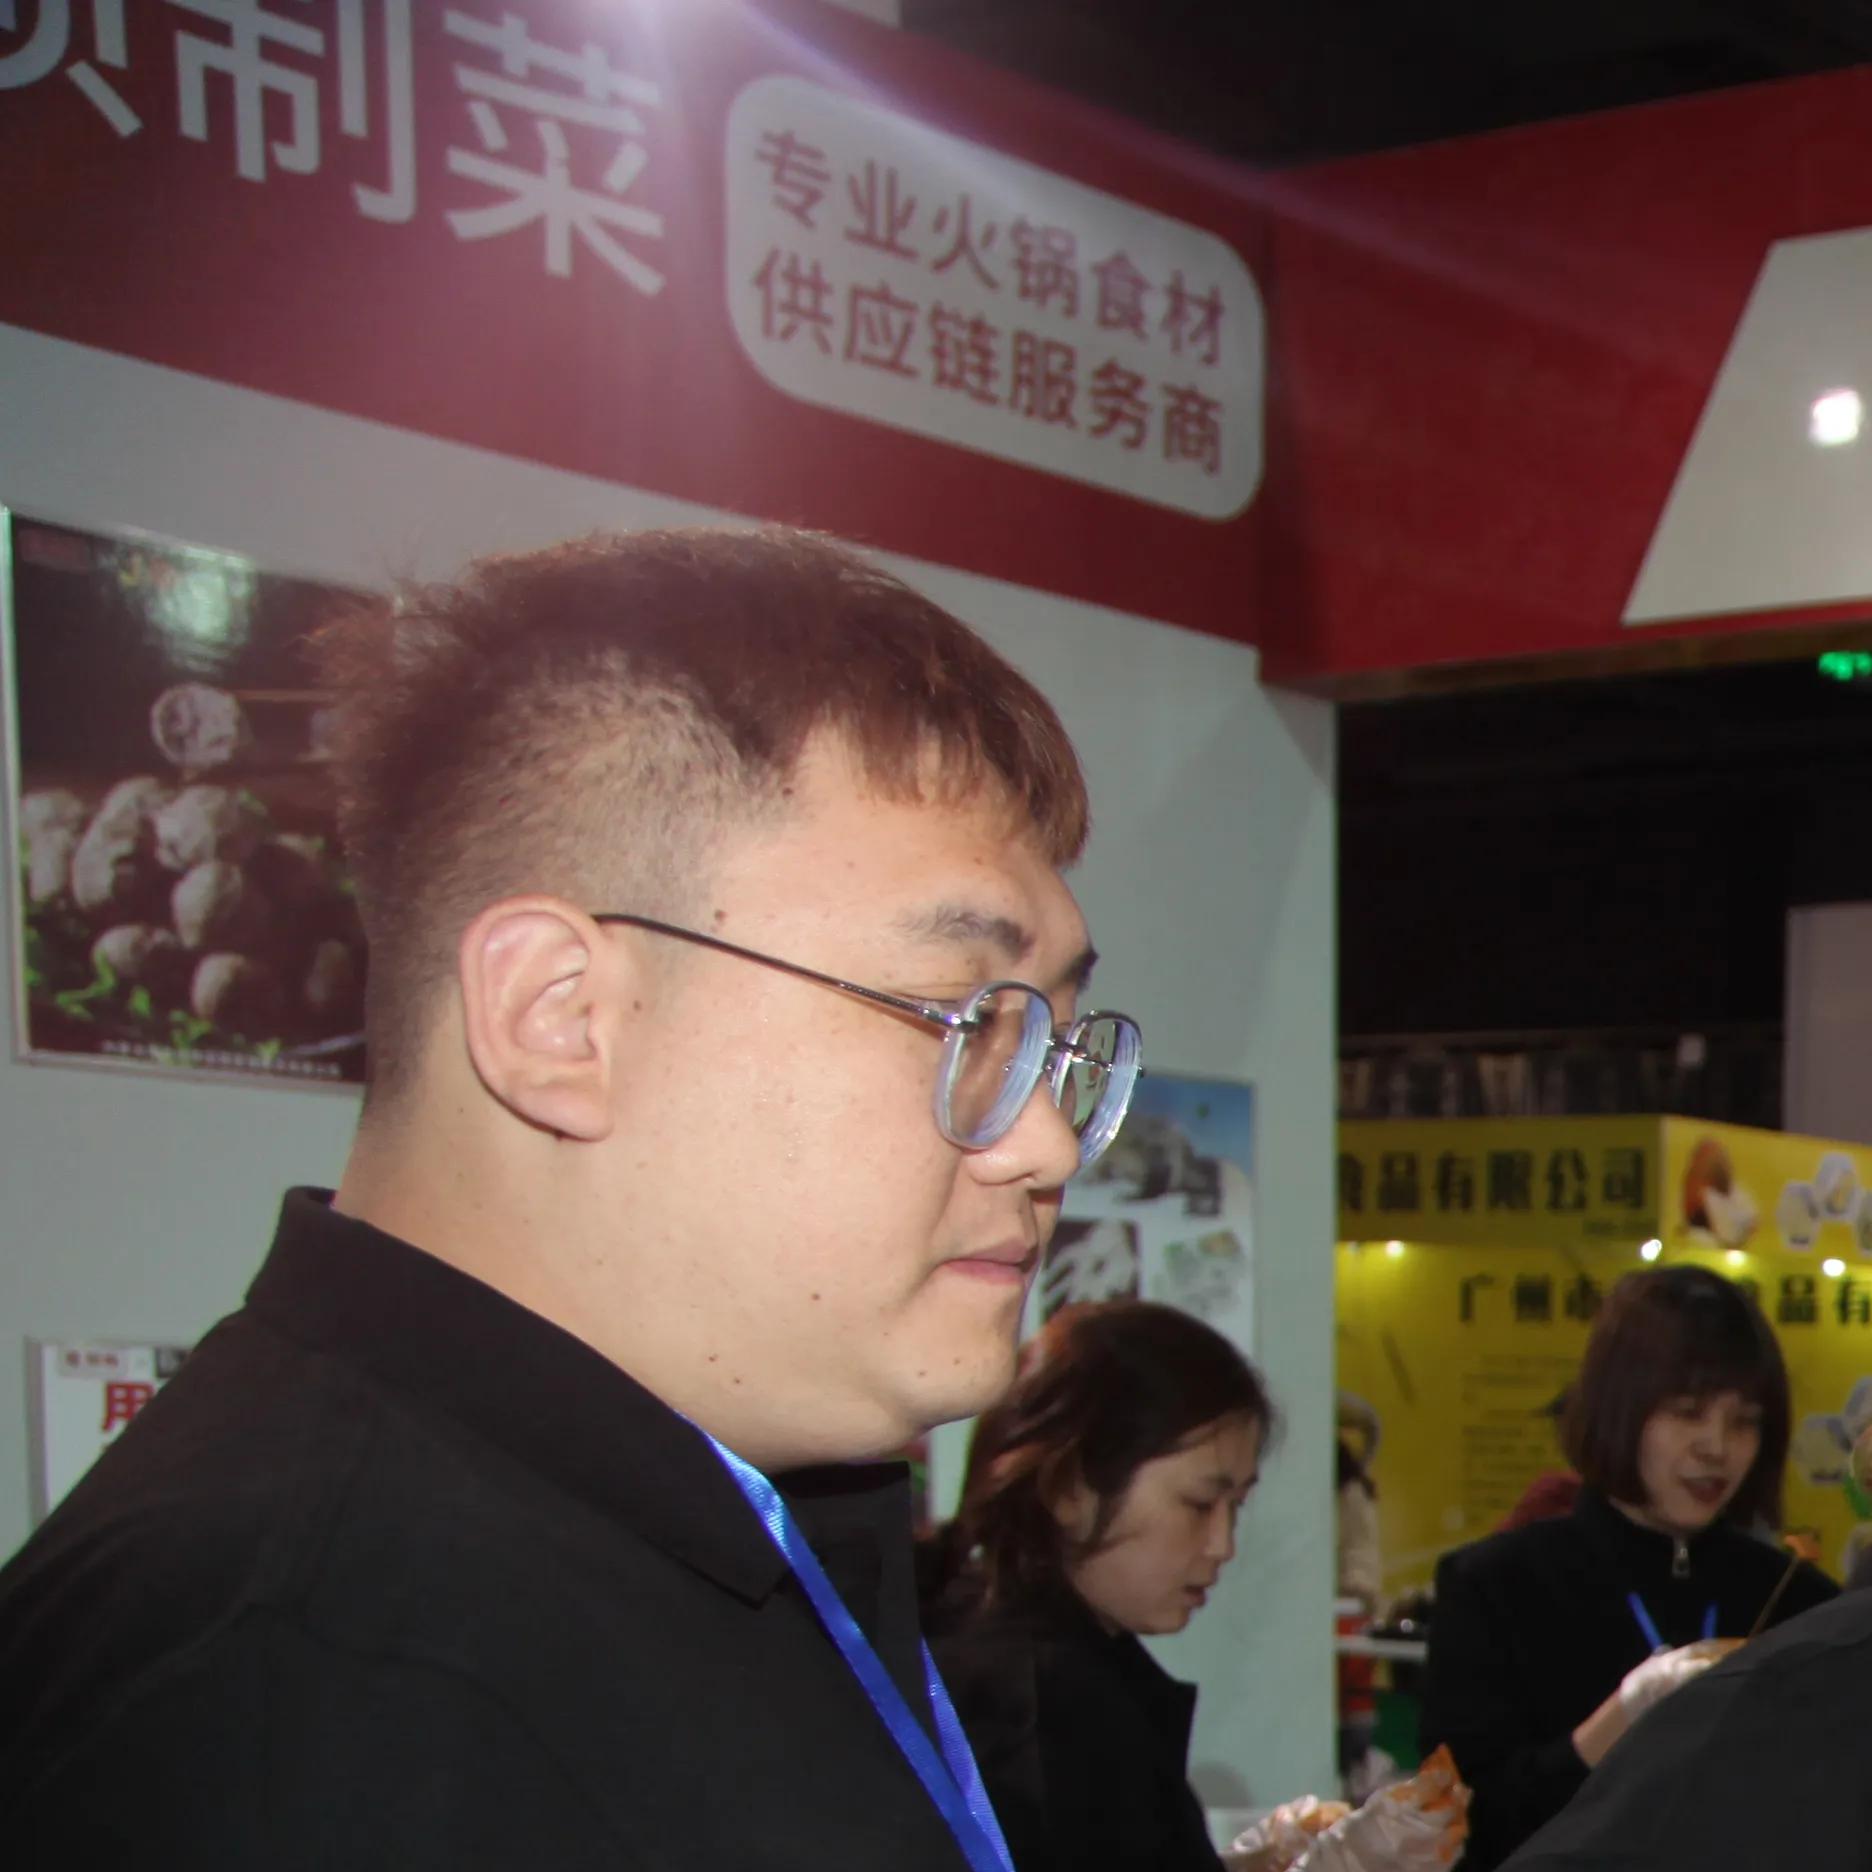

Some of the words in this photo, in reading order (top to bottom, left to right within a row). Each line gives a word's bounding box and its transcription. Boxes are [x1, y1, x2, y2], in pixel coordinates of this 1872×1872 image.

[753, 245, 1225, 477] 供应链服务商
[754, 128, 1226, 368] 专业火锅食材
